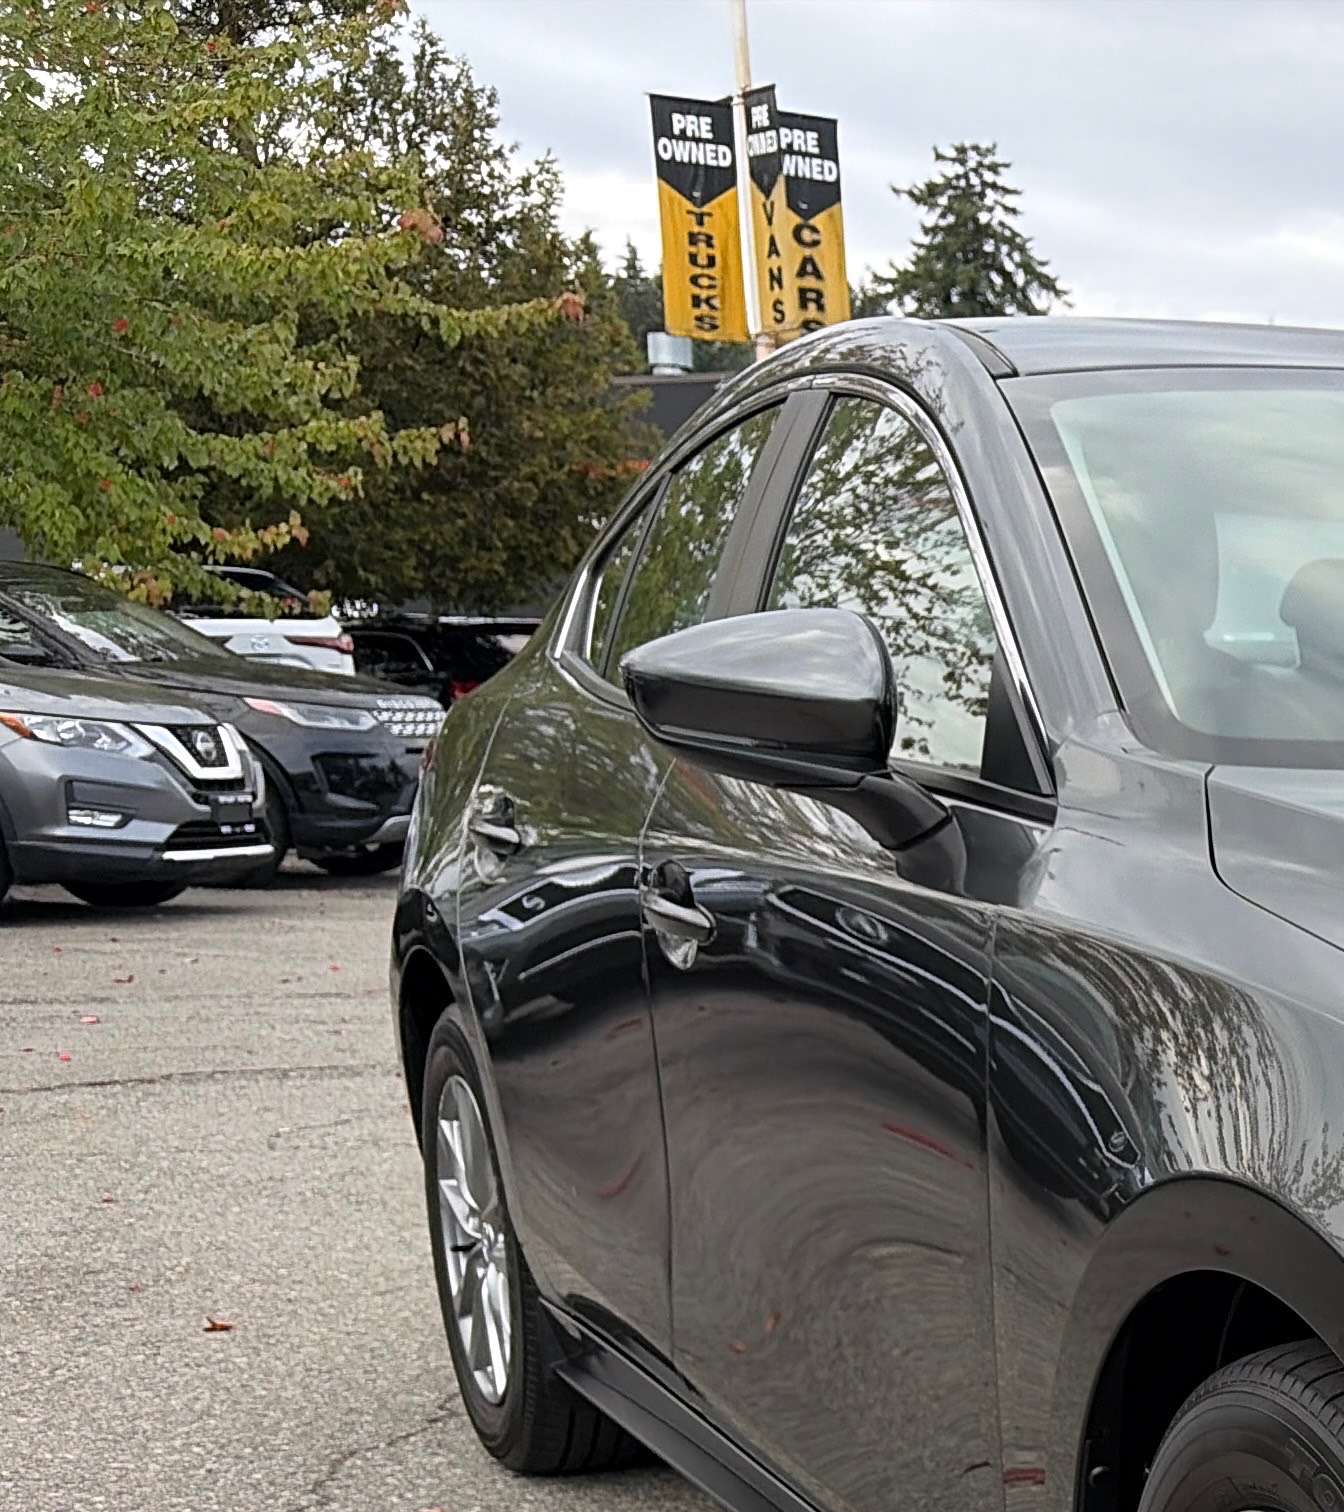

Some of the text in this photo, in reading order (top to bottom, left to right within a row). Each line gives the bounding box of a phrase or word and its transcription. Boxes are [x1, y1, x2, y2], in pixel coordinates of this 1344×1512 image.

[672, 113, 713, 139] PRE
[779, 126, 819, 155] PRE
[657, 137, 732, 167] OWNED
[686, 209, 720, 333] TRUCKS
[762, 200, 786, 324] VANS
